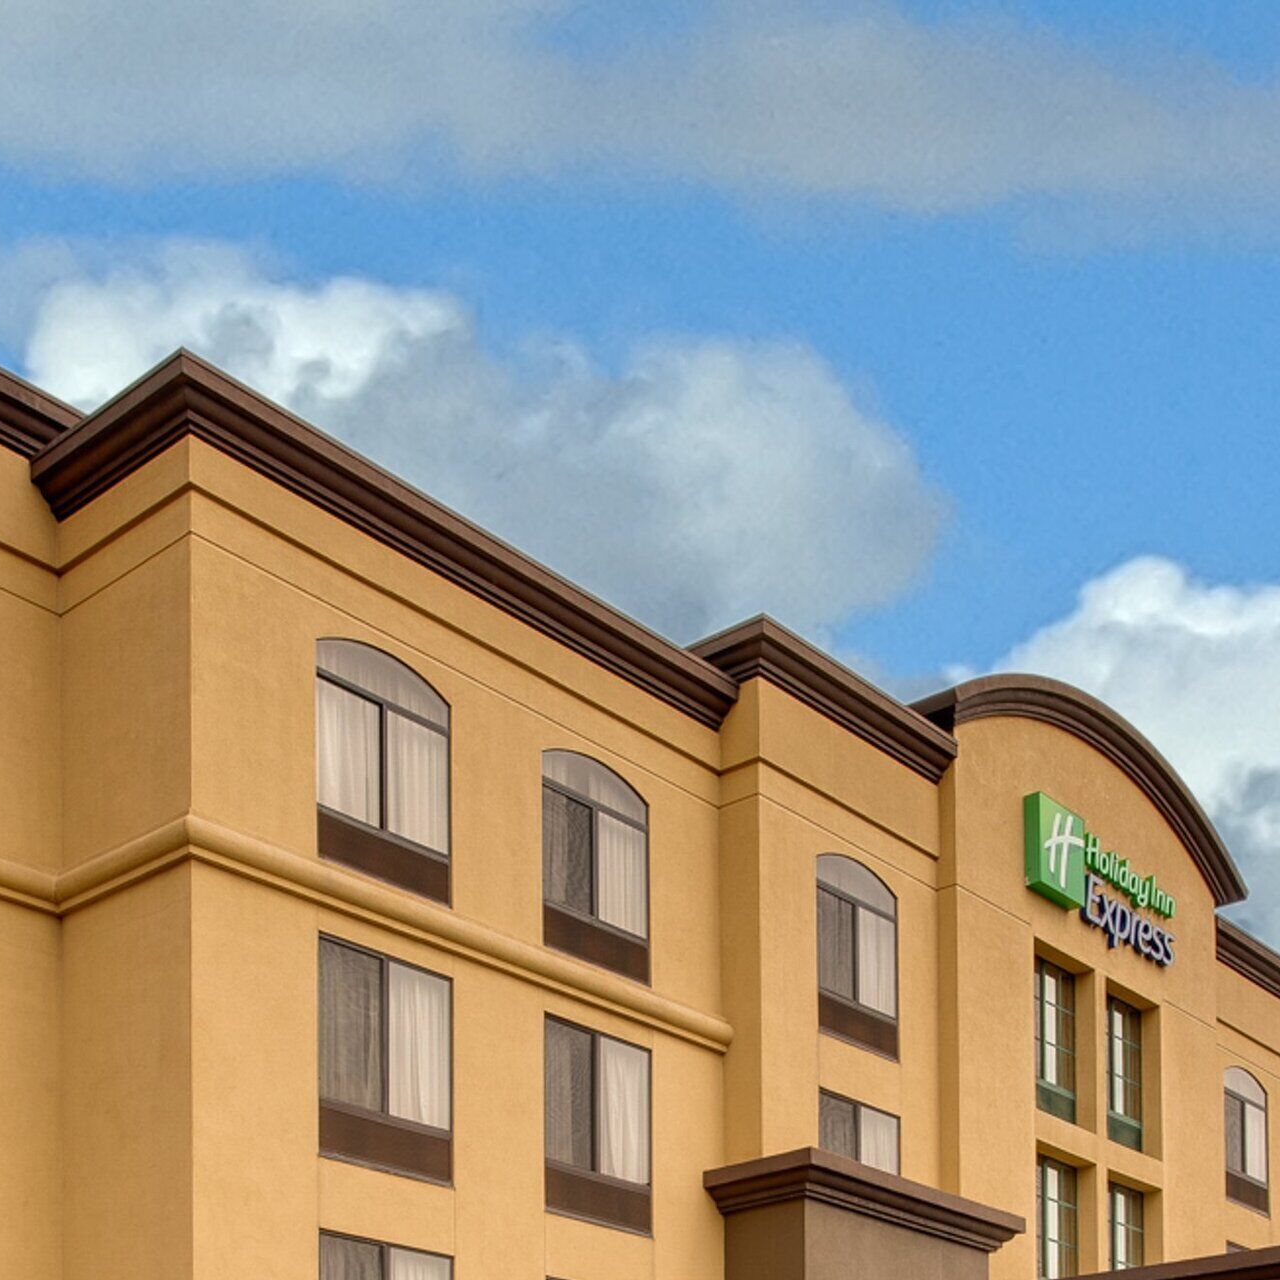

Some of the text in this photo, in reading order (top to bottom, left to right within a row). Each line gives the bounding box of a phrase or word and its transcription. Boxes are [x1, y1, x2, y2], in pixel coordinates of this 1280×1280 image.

[1085, 873, 1176, 966] Express
[1086, 832, 1176, 918] Holiday Inn
